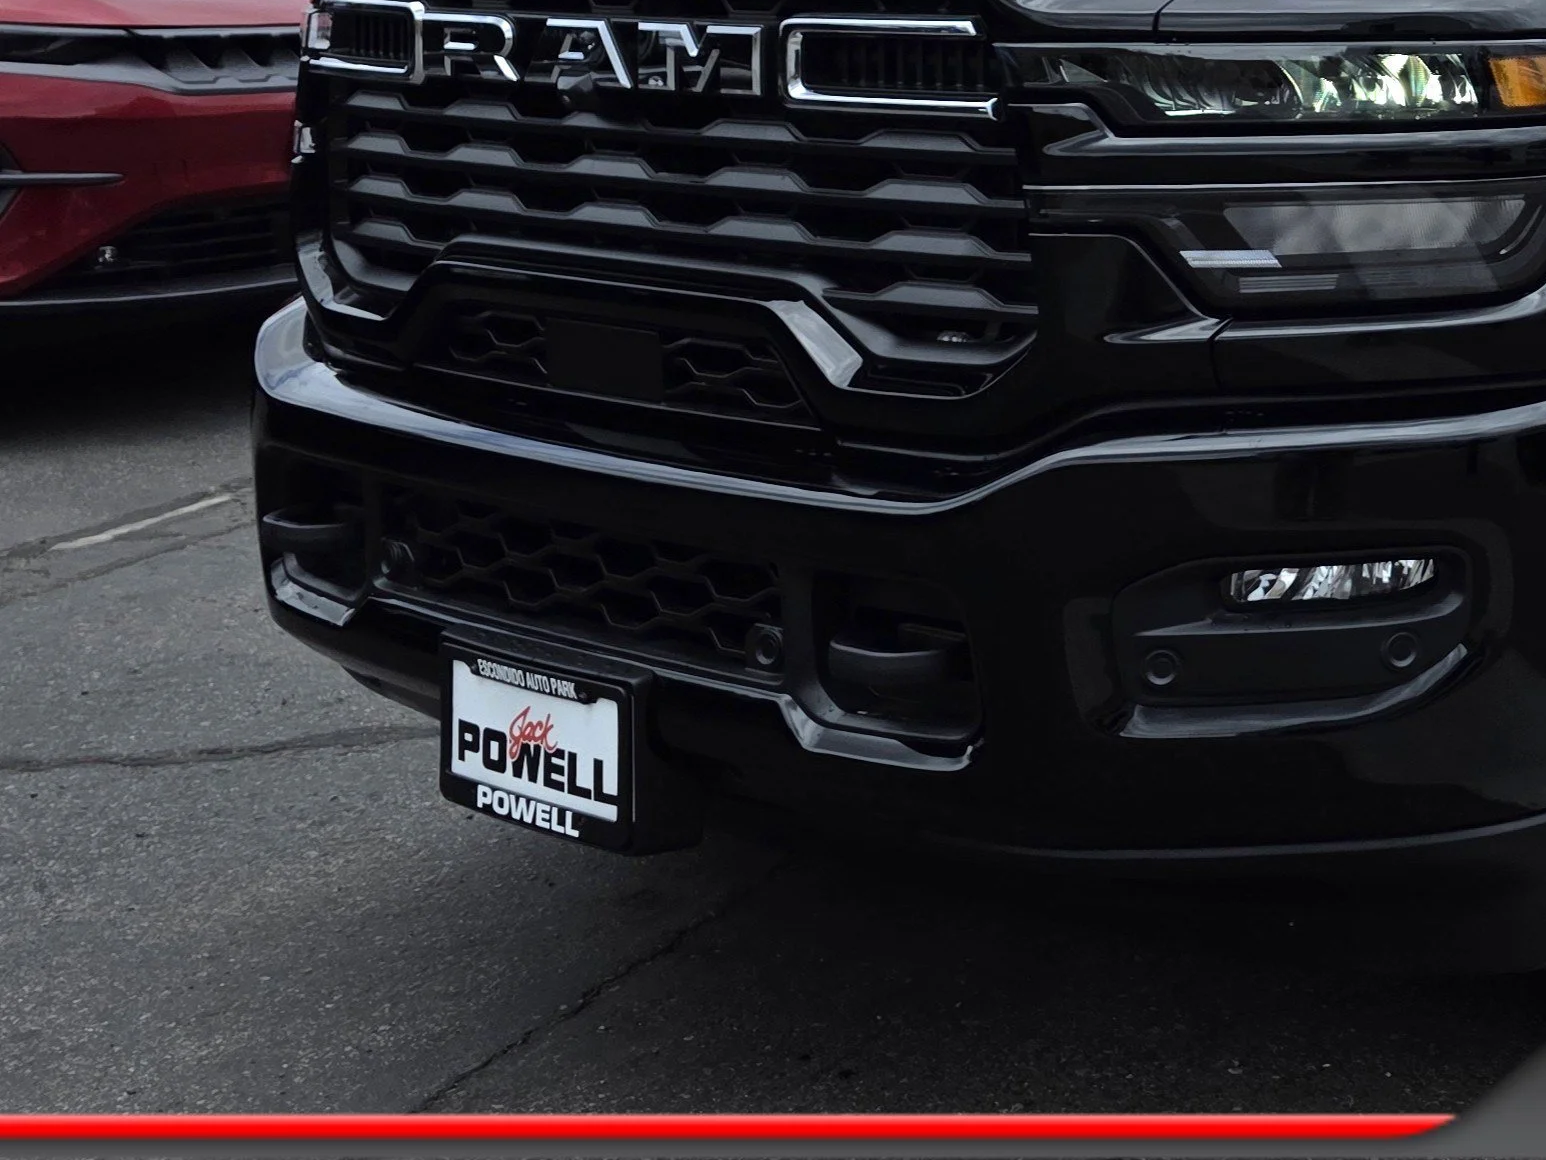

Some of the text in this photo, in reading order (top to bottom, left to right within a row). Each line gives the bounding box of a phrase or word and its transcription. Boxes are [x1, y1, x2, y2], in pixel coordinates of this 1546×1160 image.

[418, 12, 764, 96] RAM
[477, 658, 578, 700] ESCONDIDO AUTO PARK
[509, 705, 558, 761] Jack
[457, 718, 618, 807] POWELL
[477, 784, 580, 838] POWELL
